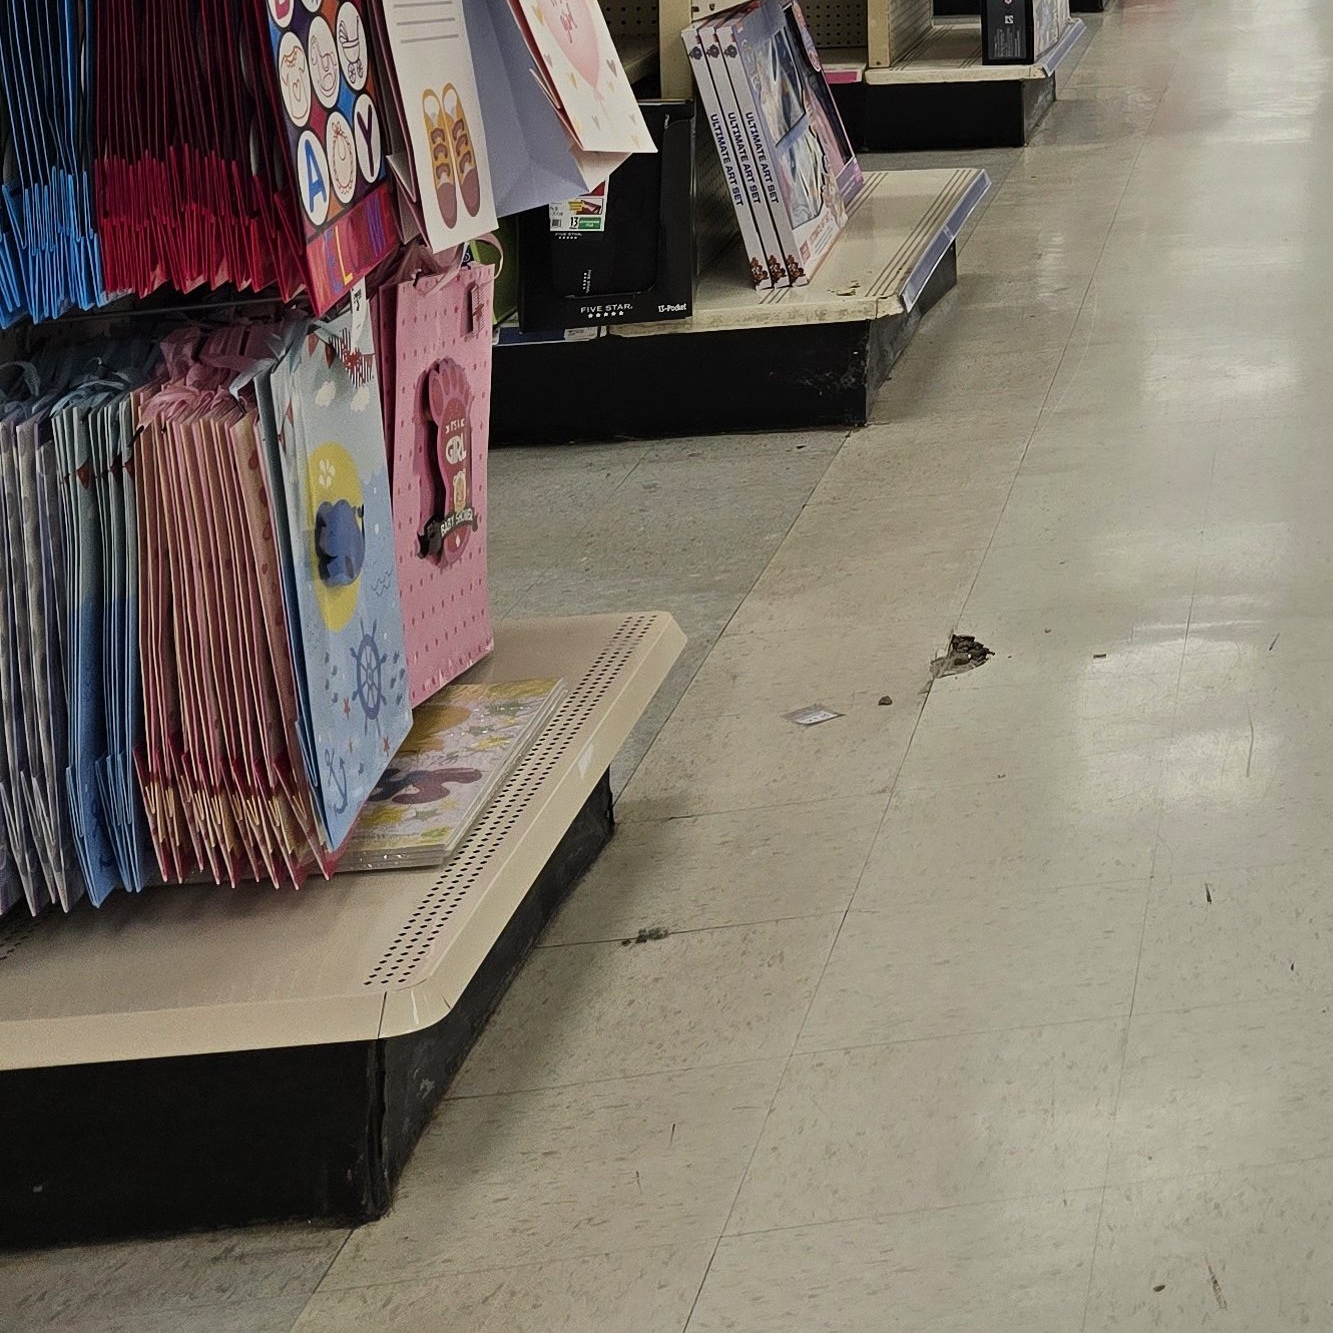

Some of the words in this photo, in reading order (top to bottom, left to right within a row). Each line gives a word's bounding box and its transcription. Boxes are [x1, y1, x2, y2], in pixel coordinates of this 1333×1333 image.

[559, 5, 579, 44] girl
[355, 114, 375, 164] Y
[744, 111, 767, 162] ULTIMATE
[709, 113, 732, 165] ULTIMATE
[724, 164, 738, 187] ART
[731, 186, 745, 206] SET
[727, 111, 750, 163] ULTIMATE
[742, 162, 756, 185] ART
[749, 184, 762, 204] SET
[759, 162, 774, 184] ART
[303, 138, 327, 219] A
[766, 184, 780, 204] SET
[569, 216, 579, 227] 13
[580, 305, 603, 314] FIVE
[605, 303, 631, 312] STAR
[445, 431, 467, 465] GIRL
[440, 515, 455, 537] BABY
[455, 507, 474, 526] SHOWER
